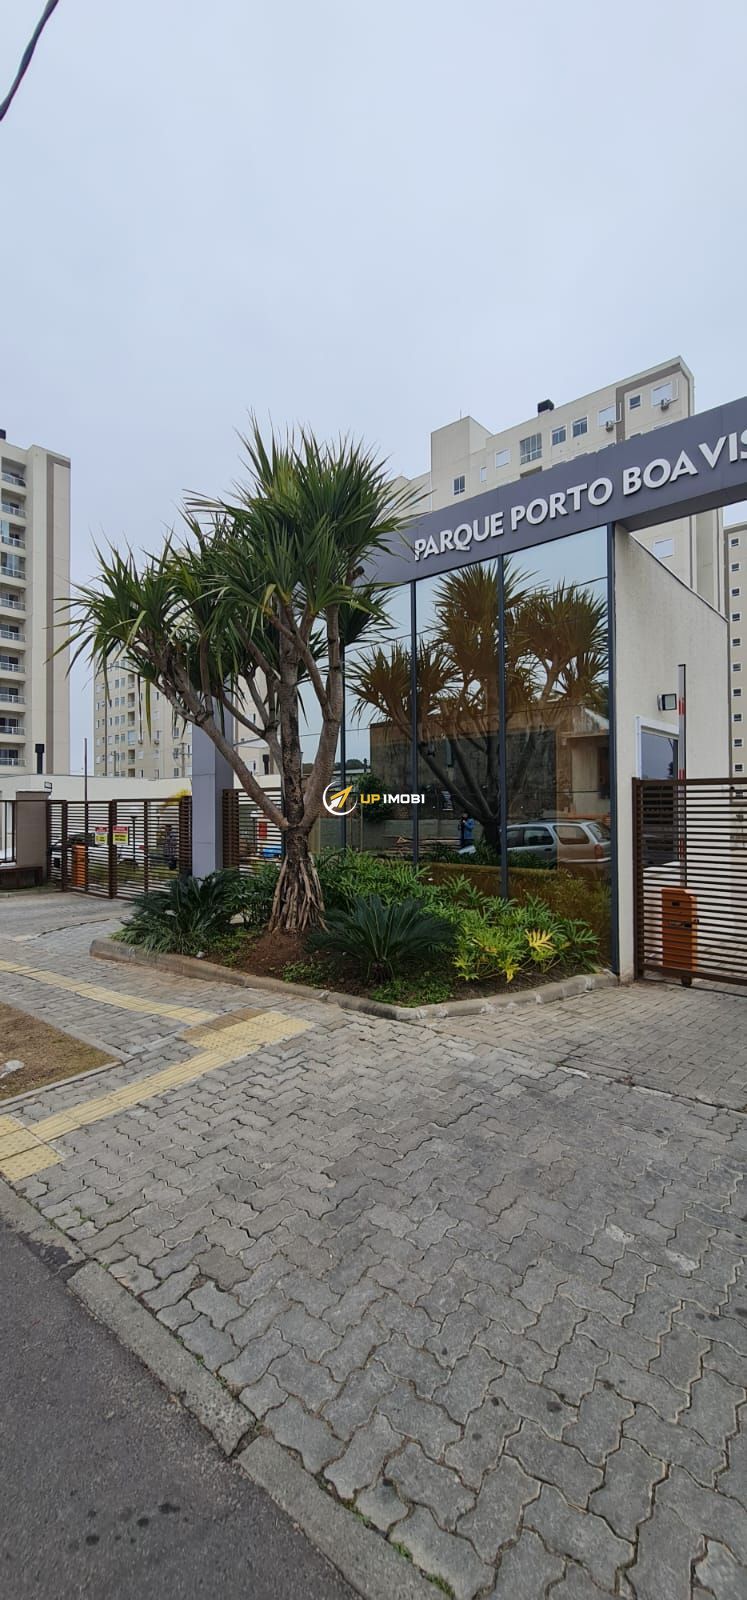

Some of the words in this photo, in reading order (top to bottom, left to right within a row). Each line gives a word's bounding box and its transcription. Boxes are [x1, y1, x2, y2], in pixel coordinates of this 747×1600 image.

[414, 512, 504, 561] PARQUE
[511, 477, 613, 531] PORTO
[622, 450, 699, 496] BOA
